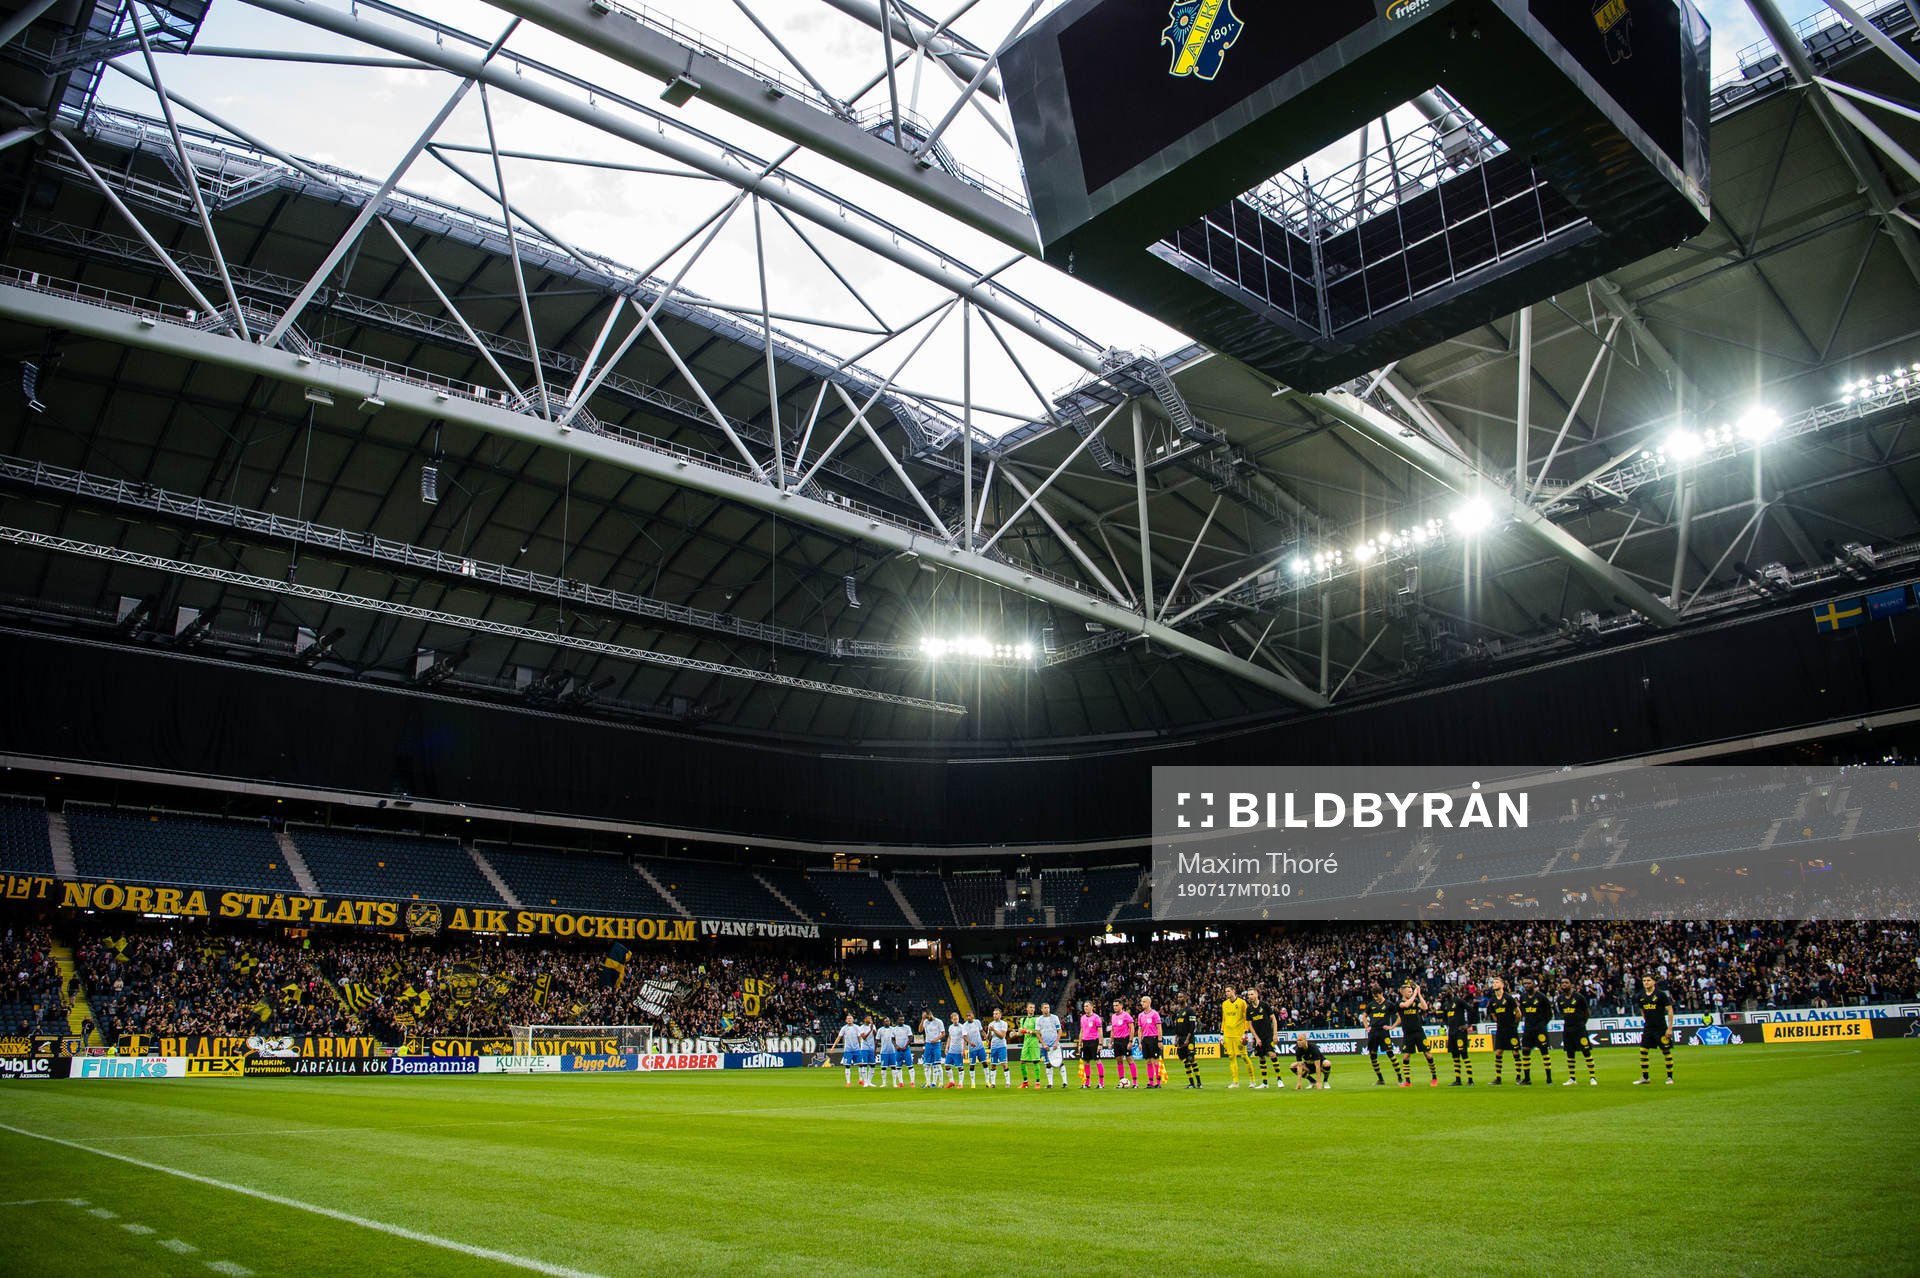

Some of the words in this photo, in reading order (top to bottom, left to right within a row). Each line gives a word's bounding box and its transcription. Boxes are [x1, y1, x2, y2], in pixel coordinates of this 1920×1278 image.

[1395, 0, 1430, 19] frien
[61, 881, 210, 916] NORRA
[219, 892, 398, 926] STÅPLATS
[448, 907, 509, 932] AIK
[517, 911, 698, 941] STOCKHOLM
[701, 920, 746, 936] IVAN
[756, 923, 820, 938] TURINA
[1774, 1024, 1861, 1038] AIKBILJETT.SE
[160, 1036, 245, 1057] BLACK
[302, 1037, 375, 1057] ARMY
[432, 1040, 478, 1056] SOL
[82, 1059, 168, 1077] Flinks
[188, 1059, 240, 1072] ITEX
[293, 1060, 356, 1073] JÄRFÄLLA
[363, 1060, 388, 1073] KÖK
[390, 1057, 477, 1073] Bemannia
[496, 1057, 544, 1067] KUNTZE
[573, 1055, 627, 1070] Bygg-Ole
[641, 1055, 718, 1069] GRABBER
